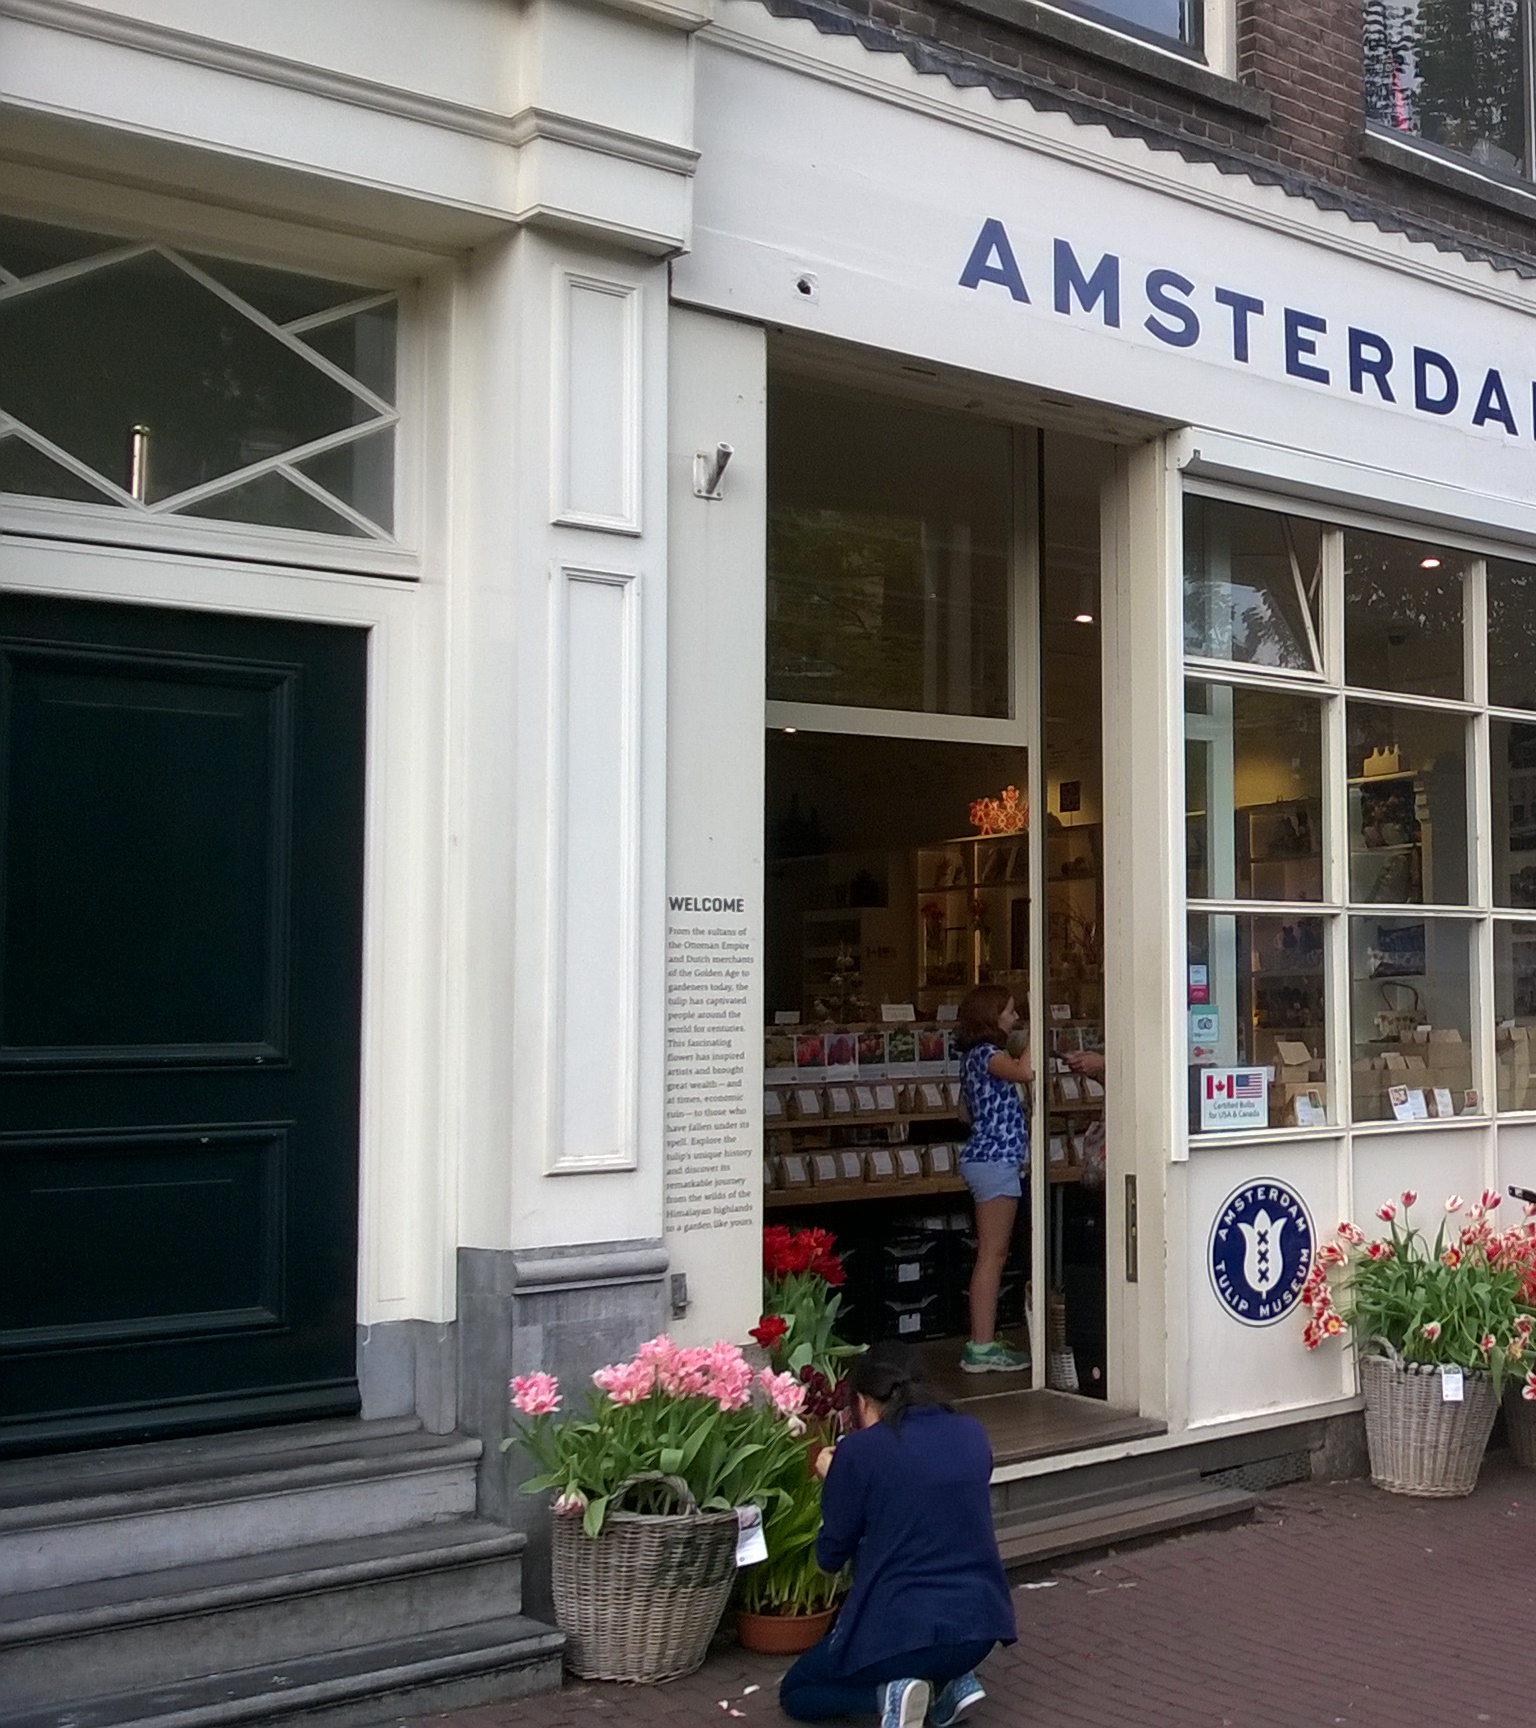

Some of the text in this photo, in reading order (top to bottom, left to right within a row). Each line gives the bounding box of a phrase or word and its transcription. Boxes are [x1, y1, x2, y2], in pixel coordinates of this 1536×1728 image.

[669, 897, 744, 912] WELCOME
[1218, 1187, 1306, 1241] AMSTERDAM
[1216, 1248, 1309, 1317] TULIP MUSEUM
